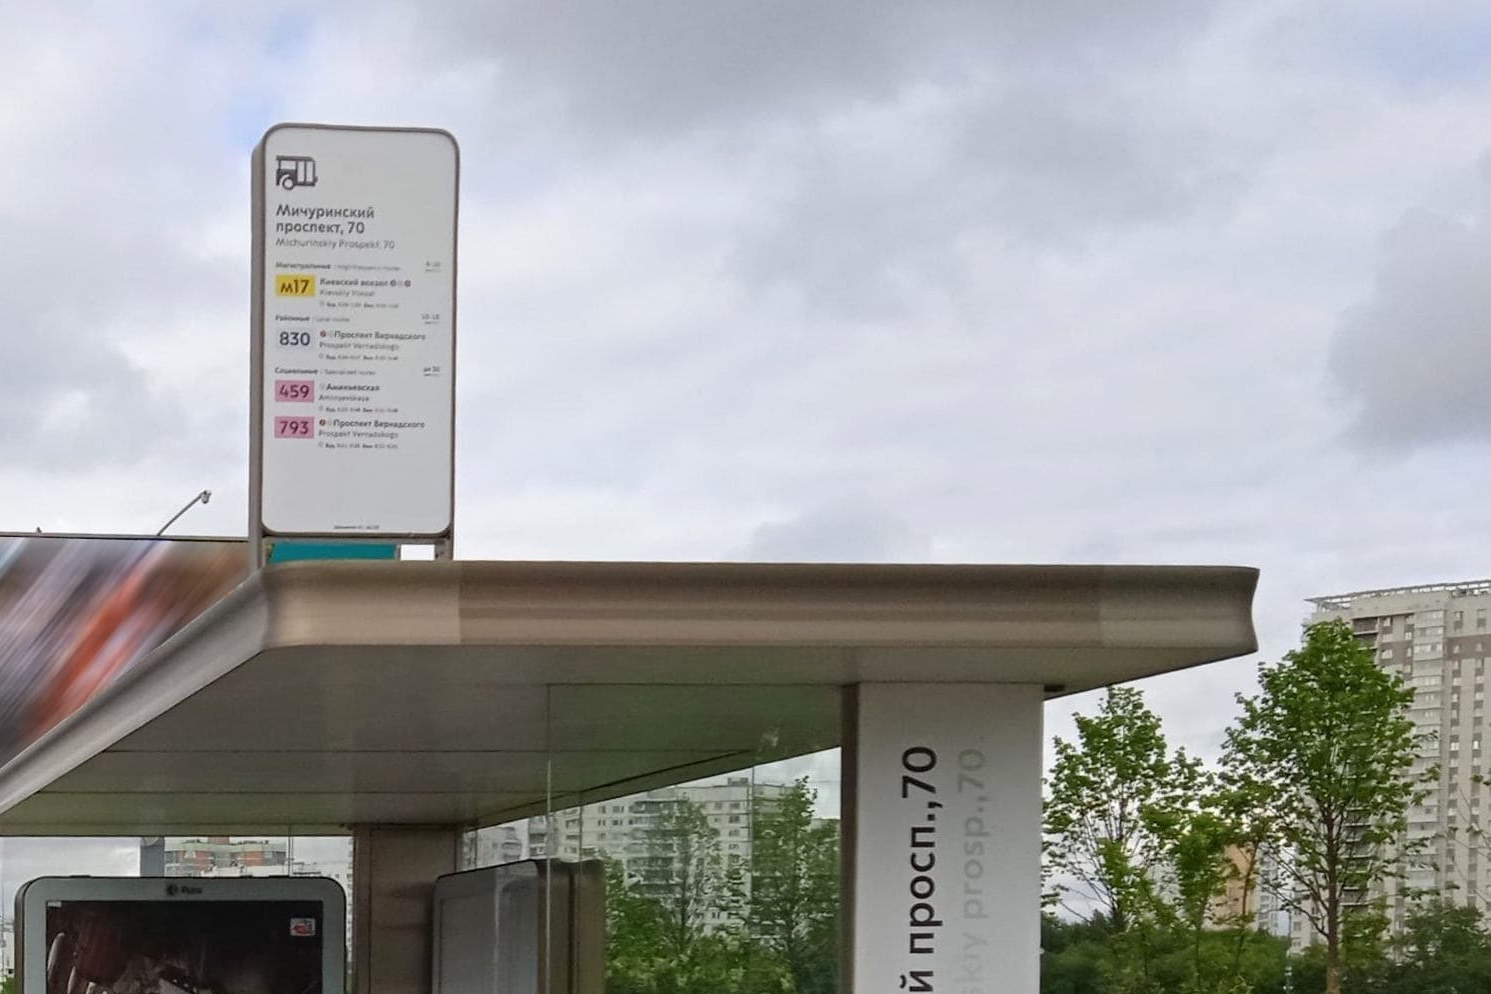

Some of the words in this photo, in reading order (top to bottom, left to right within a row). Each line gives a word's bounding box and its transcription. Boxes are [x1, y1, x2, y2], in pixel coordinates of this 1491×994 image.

[276, 204, 374, 219] Мичуринский
[276, 222, 343, 235] проспект,
[348, 221, 365, 234] 70
[383, 240, 395, 249] 70
[279, 332, 311, 346] 830
[335, 331, 373, 340] Проспект
[280, 385, 309, 398] 459
[280, 421, 309, 435] 793
[333, 419, 372, 428] Проспект
